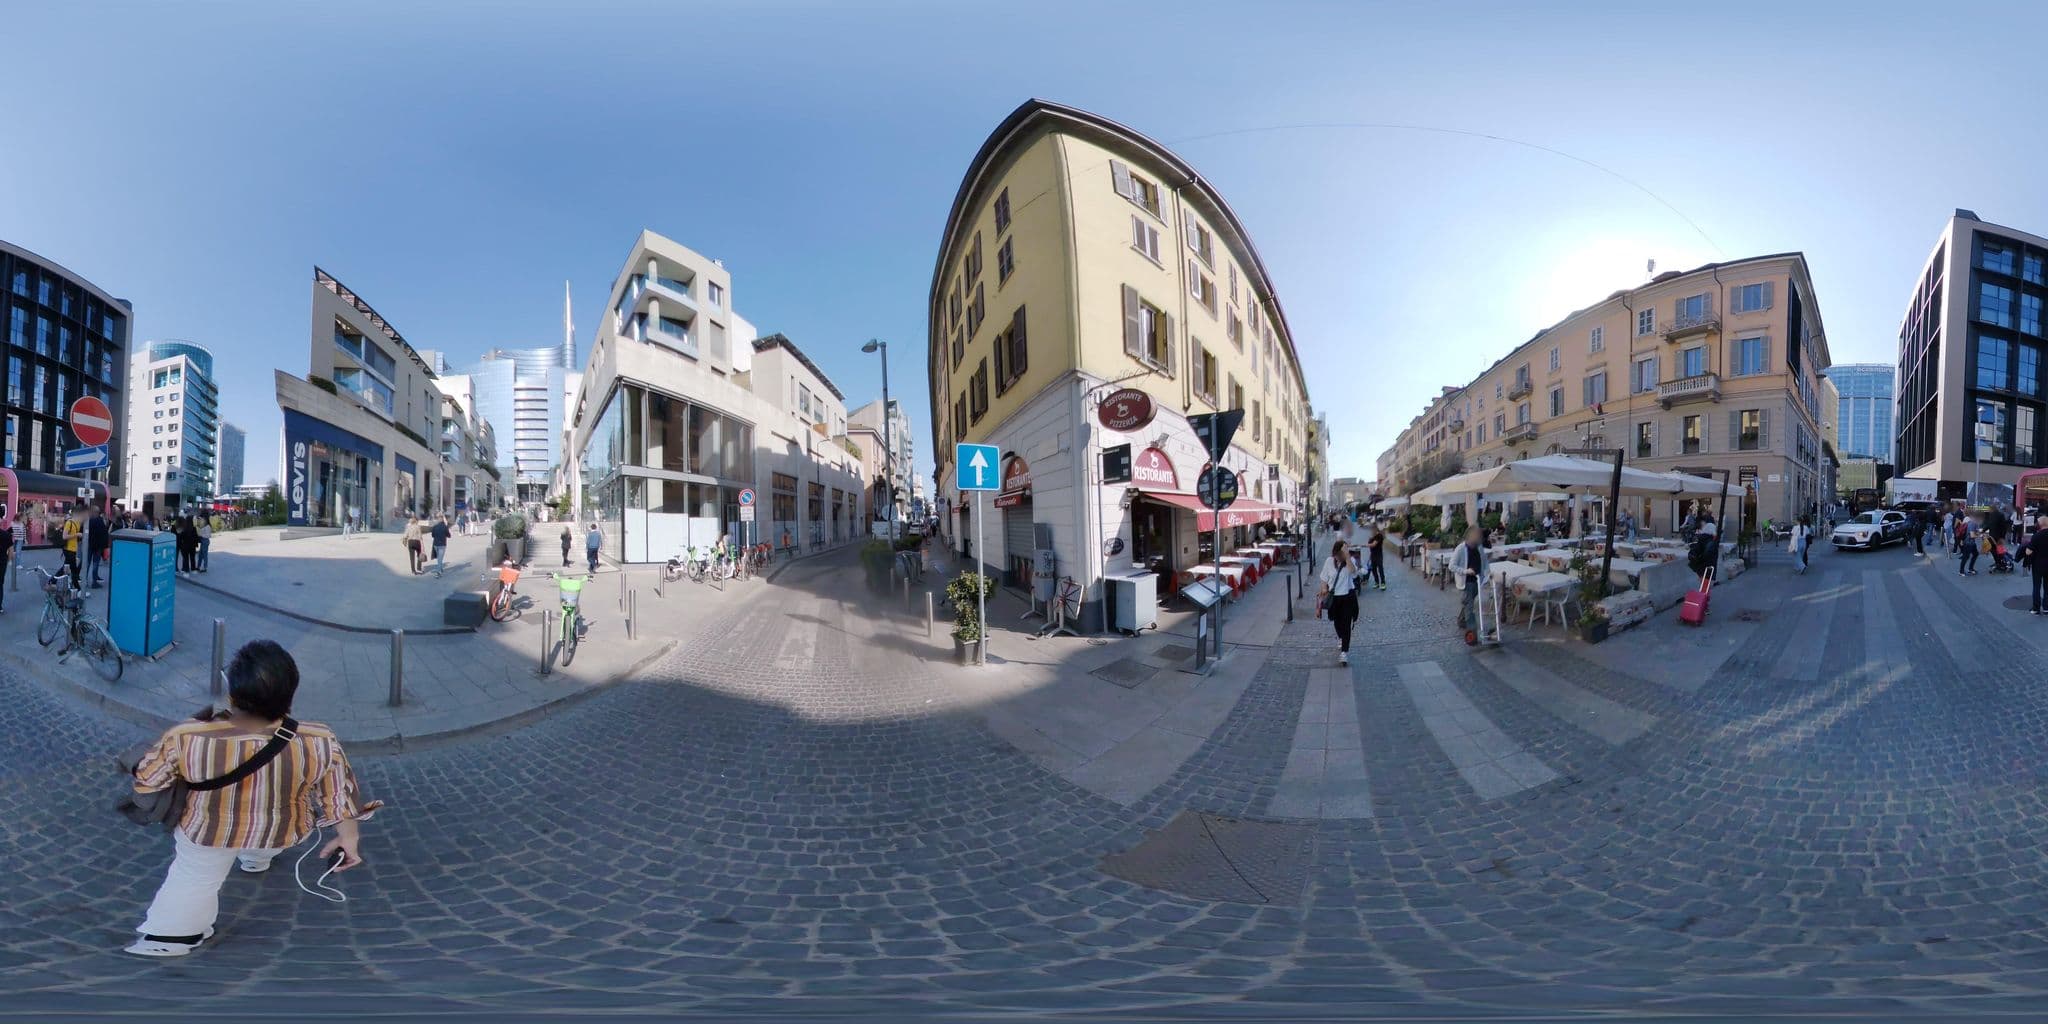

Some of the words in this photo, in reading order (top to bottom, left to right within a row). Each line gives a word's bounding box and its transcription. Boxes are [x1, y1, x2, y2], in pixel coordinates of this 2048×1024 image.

[1104, 392, 1143, 408] RISTORANTE
[1110, 416, 1138, 428] PIZZERIA
[1006, 472, 1032, 489] RISTORANTE
[1134, 466, 1174, 484] RISTORANTE
